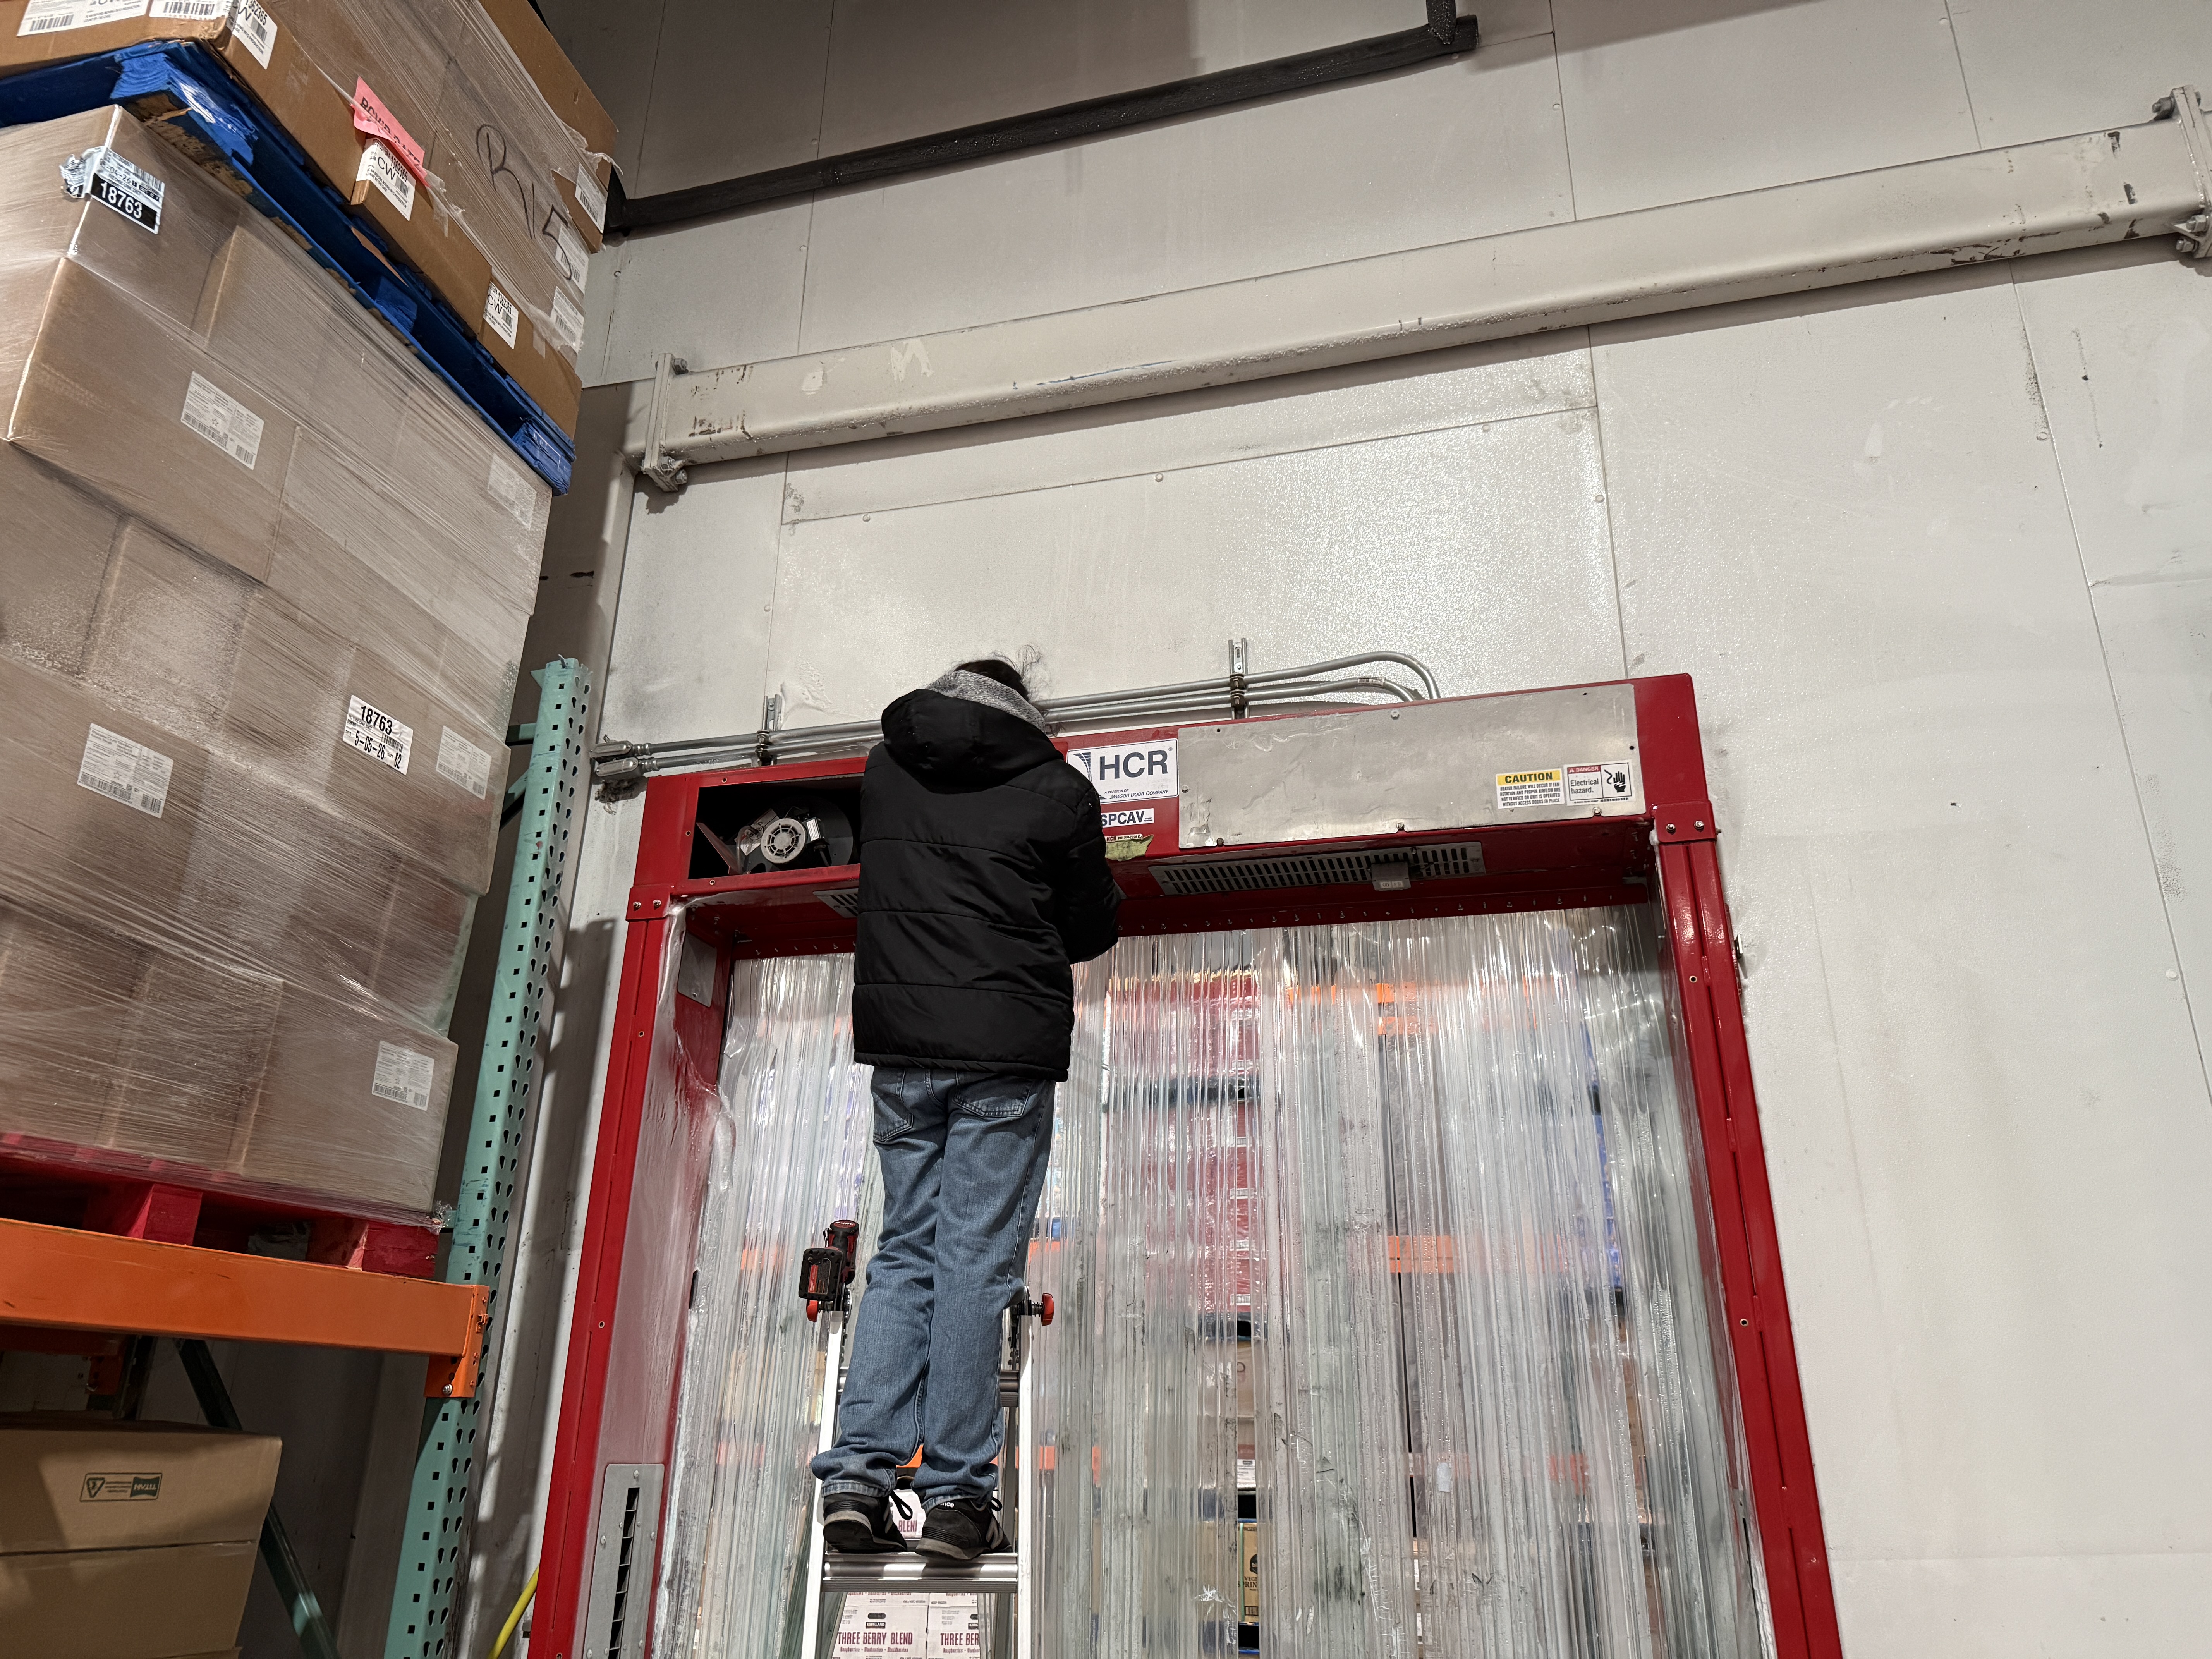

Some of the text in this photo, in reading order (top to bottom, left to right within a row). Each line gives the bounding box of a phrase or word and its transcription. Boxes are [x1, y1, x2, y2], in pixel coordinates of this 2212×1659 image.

[378, 156, 395, 180] CW
[391, 156, 408, 182] 1362365
[101, 182, 142, 218] 18763
[487, 294, 502, 314] CW
[361, 706, 392, 735] 18763
[355, 730, 385, 760] 5-05-26
[394, 752, 402, 769] 62
[1100, 750, 1168, 781] HCR
[1505, 772, 1553, 783] CAUTION
[1570, 778, 1599, 787] Electrical
[1101, 811, 1145, 826] SPCAV
[838, 1632, 913, 1645] THREE BERRY BLEND
[940, 1633, 963, 1645] THREE
